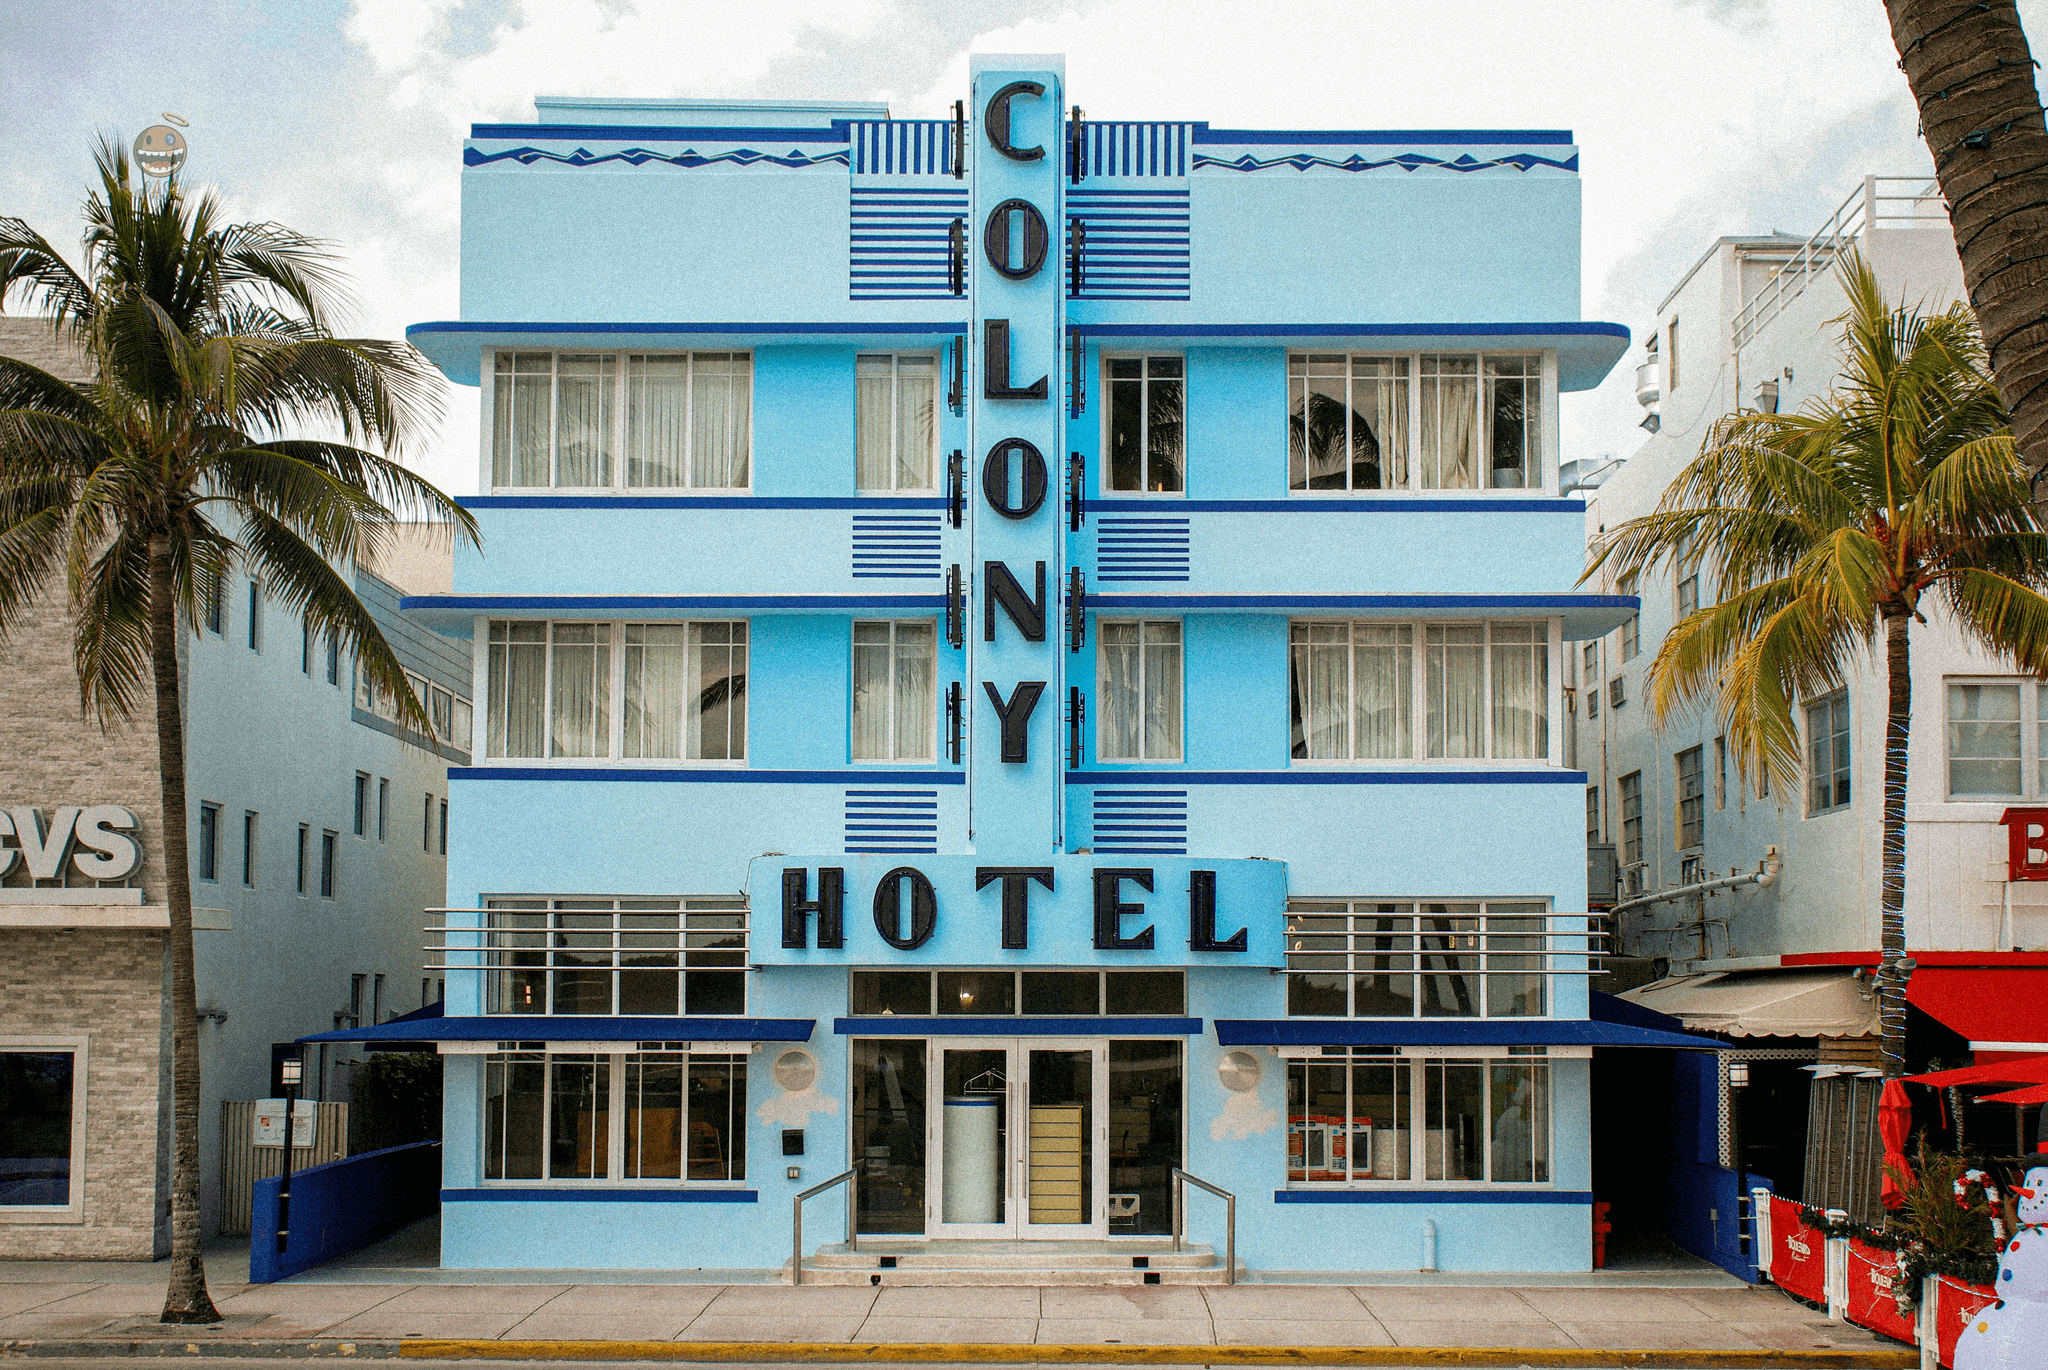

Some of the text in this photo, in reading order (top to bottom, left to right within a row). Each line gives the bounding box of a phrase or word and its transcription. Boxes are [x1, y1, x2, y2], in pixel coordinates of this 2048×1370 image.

[982, 80, 1048, 764] COLONY
[0, 805, 143, 881] VS
[782, 866, 1248, 952] HOTEL
